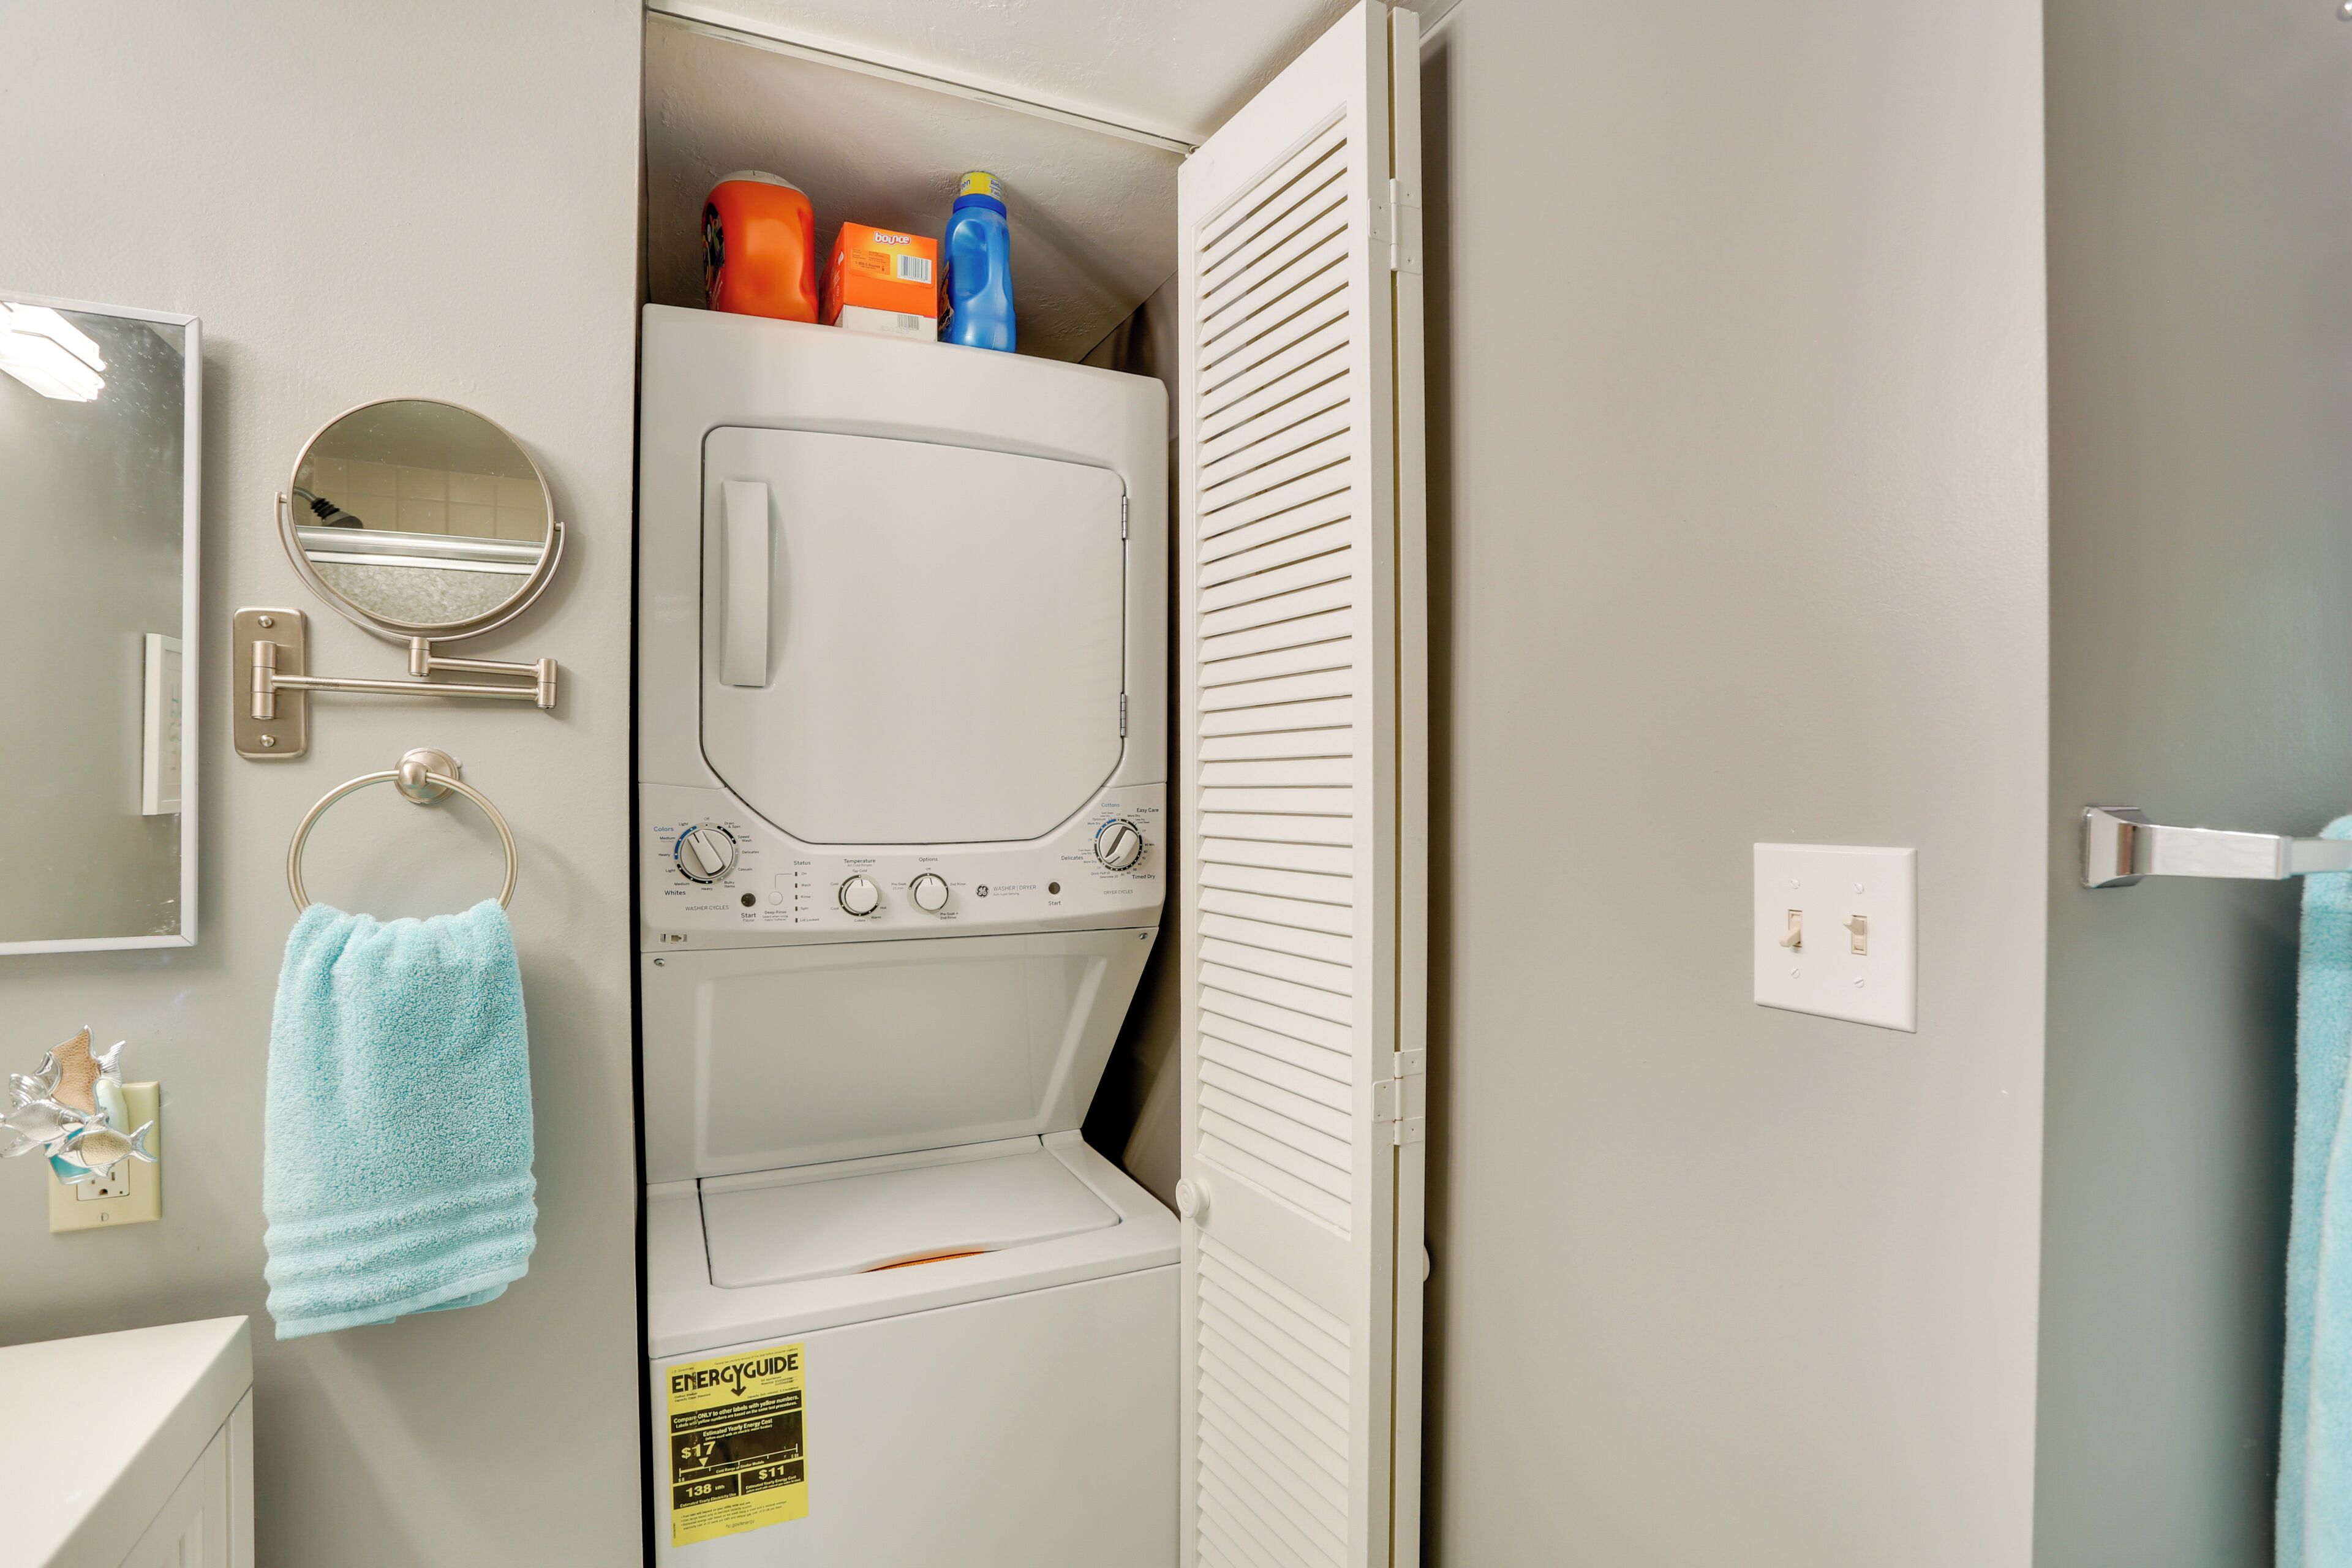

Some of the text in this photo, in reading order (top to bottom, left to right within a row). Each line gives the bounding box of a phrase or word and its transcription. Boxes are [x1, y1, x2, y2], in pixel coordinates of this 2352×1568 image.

[875, 232, 911, 245] bounce
[672, 1353, 798, 1393] ENERGYGUIDE
[703, 1427, 727, 1437] Estimated
[681, 1441, 715, 1460] $17
[759, 1465, 784, 1480] $11
[686, 1483, 712, 1498] 138
